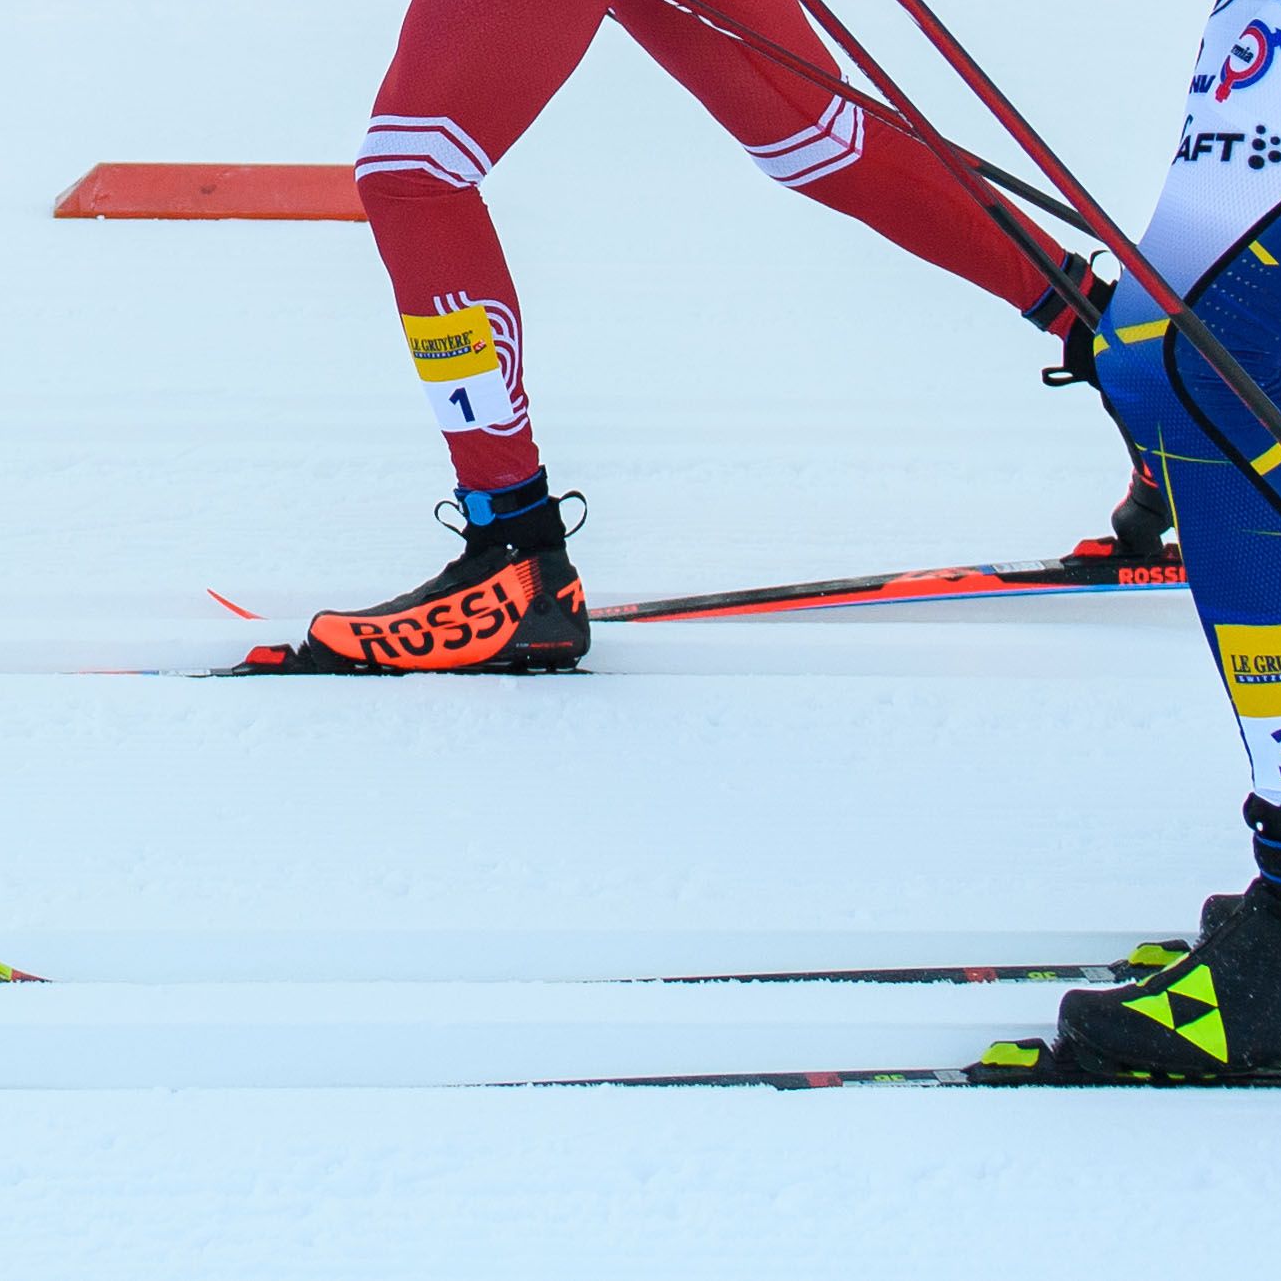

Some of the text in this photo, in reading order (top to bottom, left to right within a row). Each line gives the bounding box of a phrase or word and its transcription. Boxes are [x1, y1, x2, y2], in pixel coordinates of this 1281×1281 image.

[449, 387, 476, 423] 1
[349, 583, 519, 662] ROSSI
[1230, 654, 1251, 674] LE
